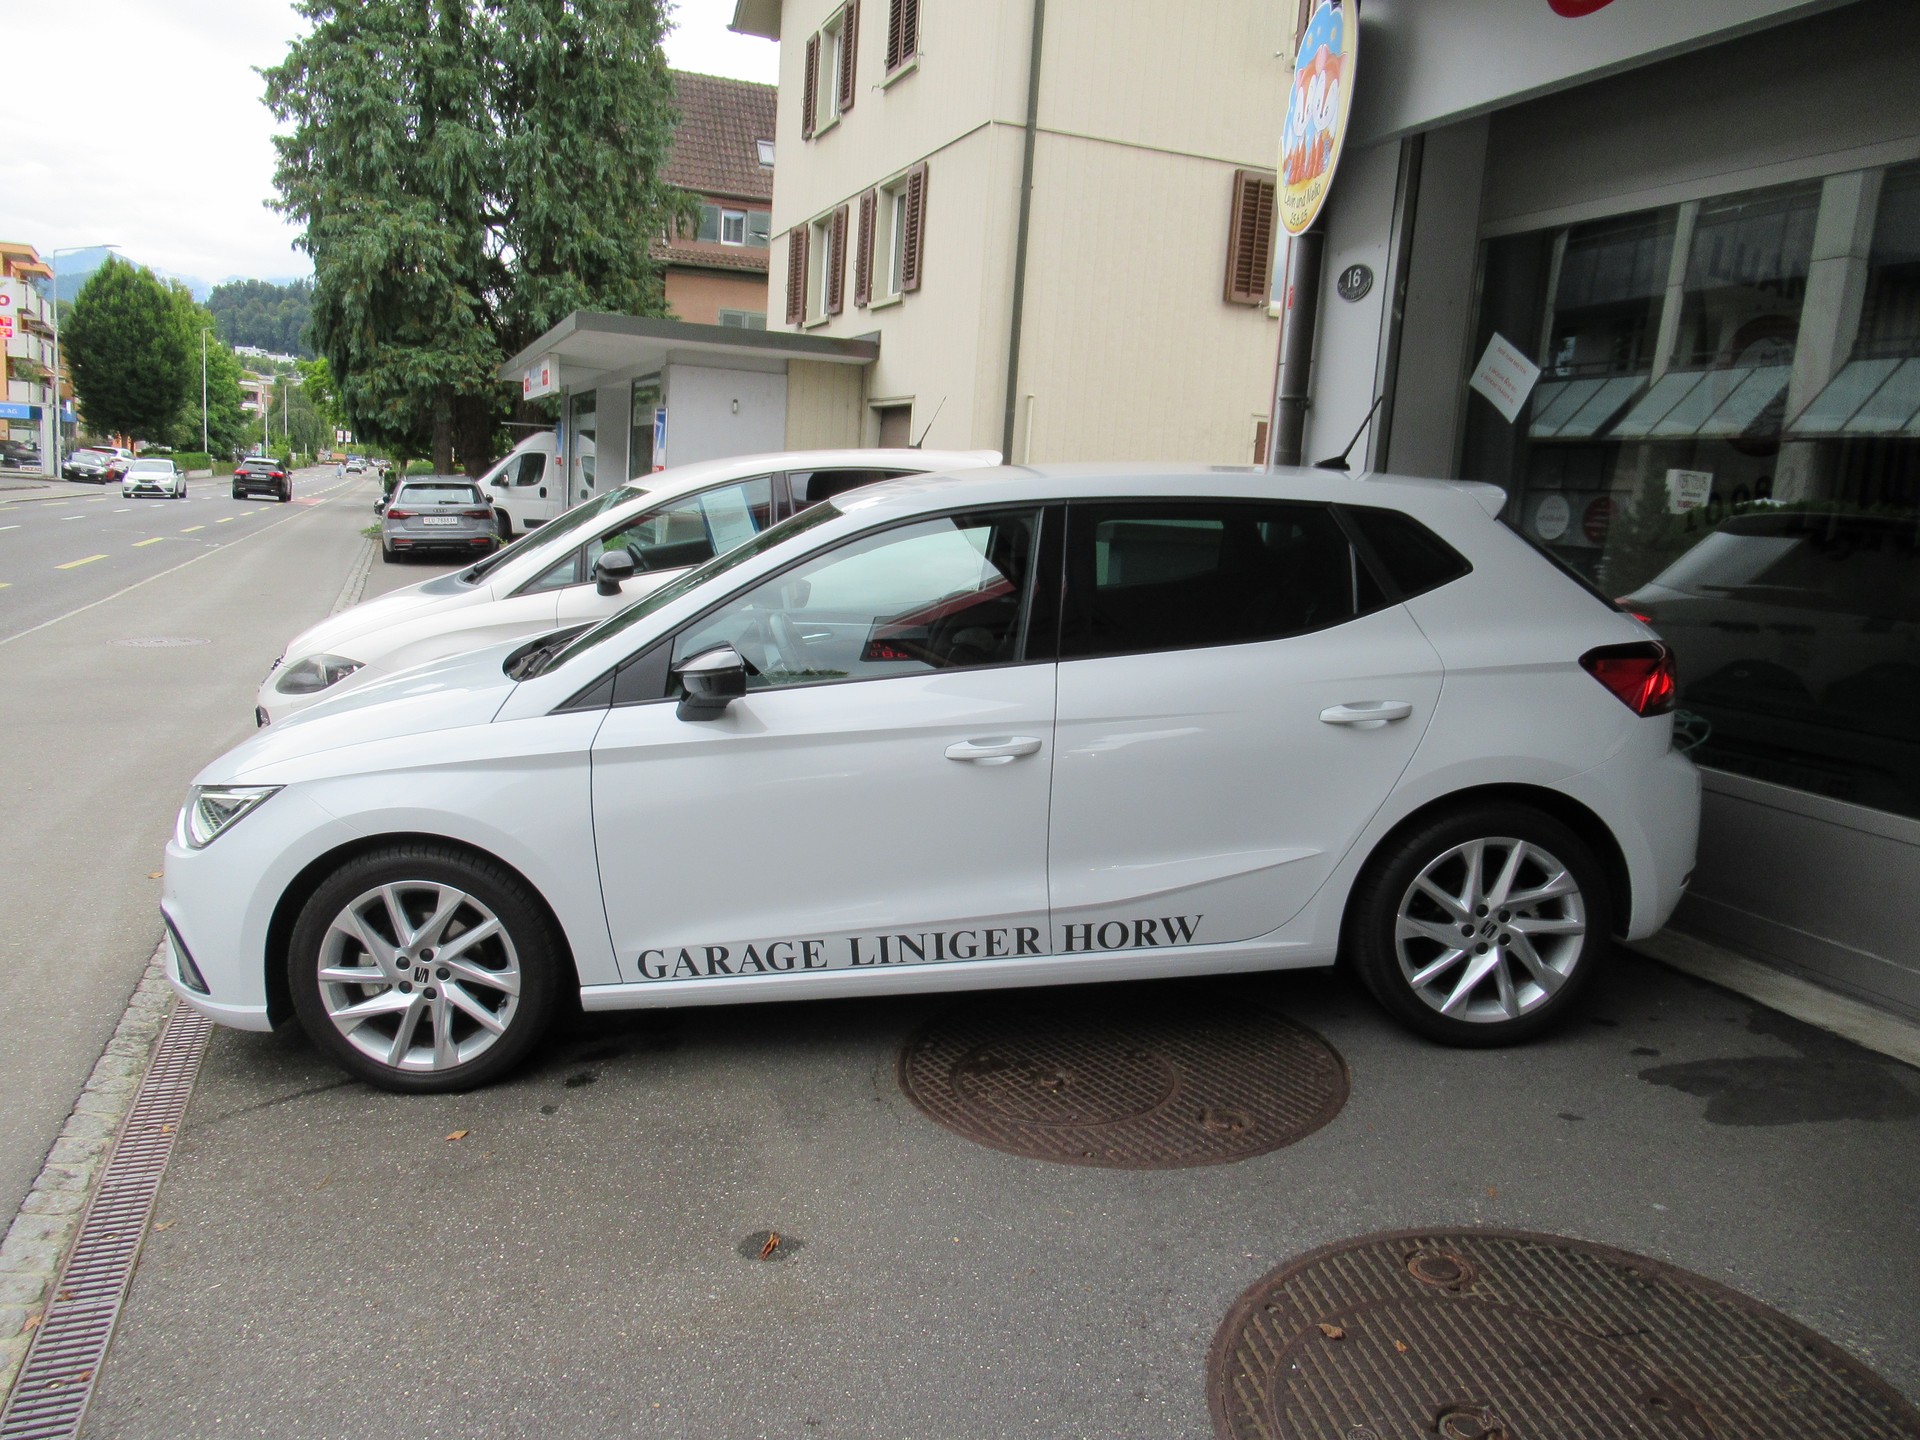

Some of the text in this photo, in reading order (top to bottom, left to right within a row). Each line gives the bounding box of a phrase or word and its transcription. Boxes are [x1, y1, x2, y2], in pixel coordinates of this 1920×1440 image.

[1347, 267, 1362, 289] 16
[637, 914, 1204, 979] GARAGE LINIGER HORW
